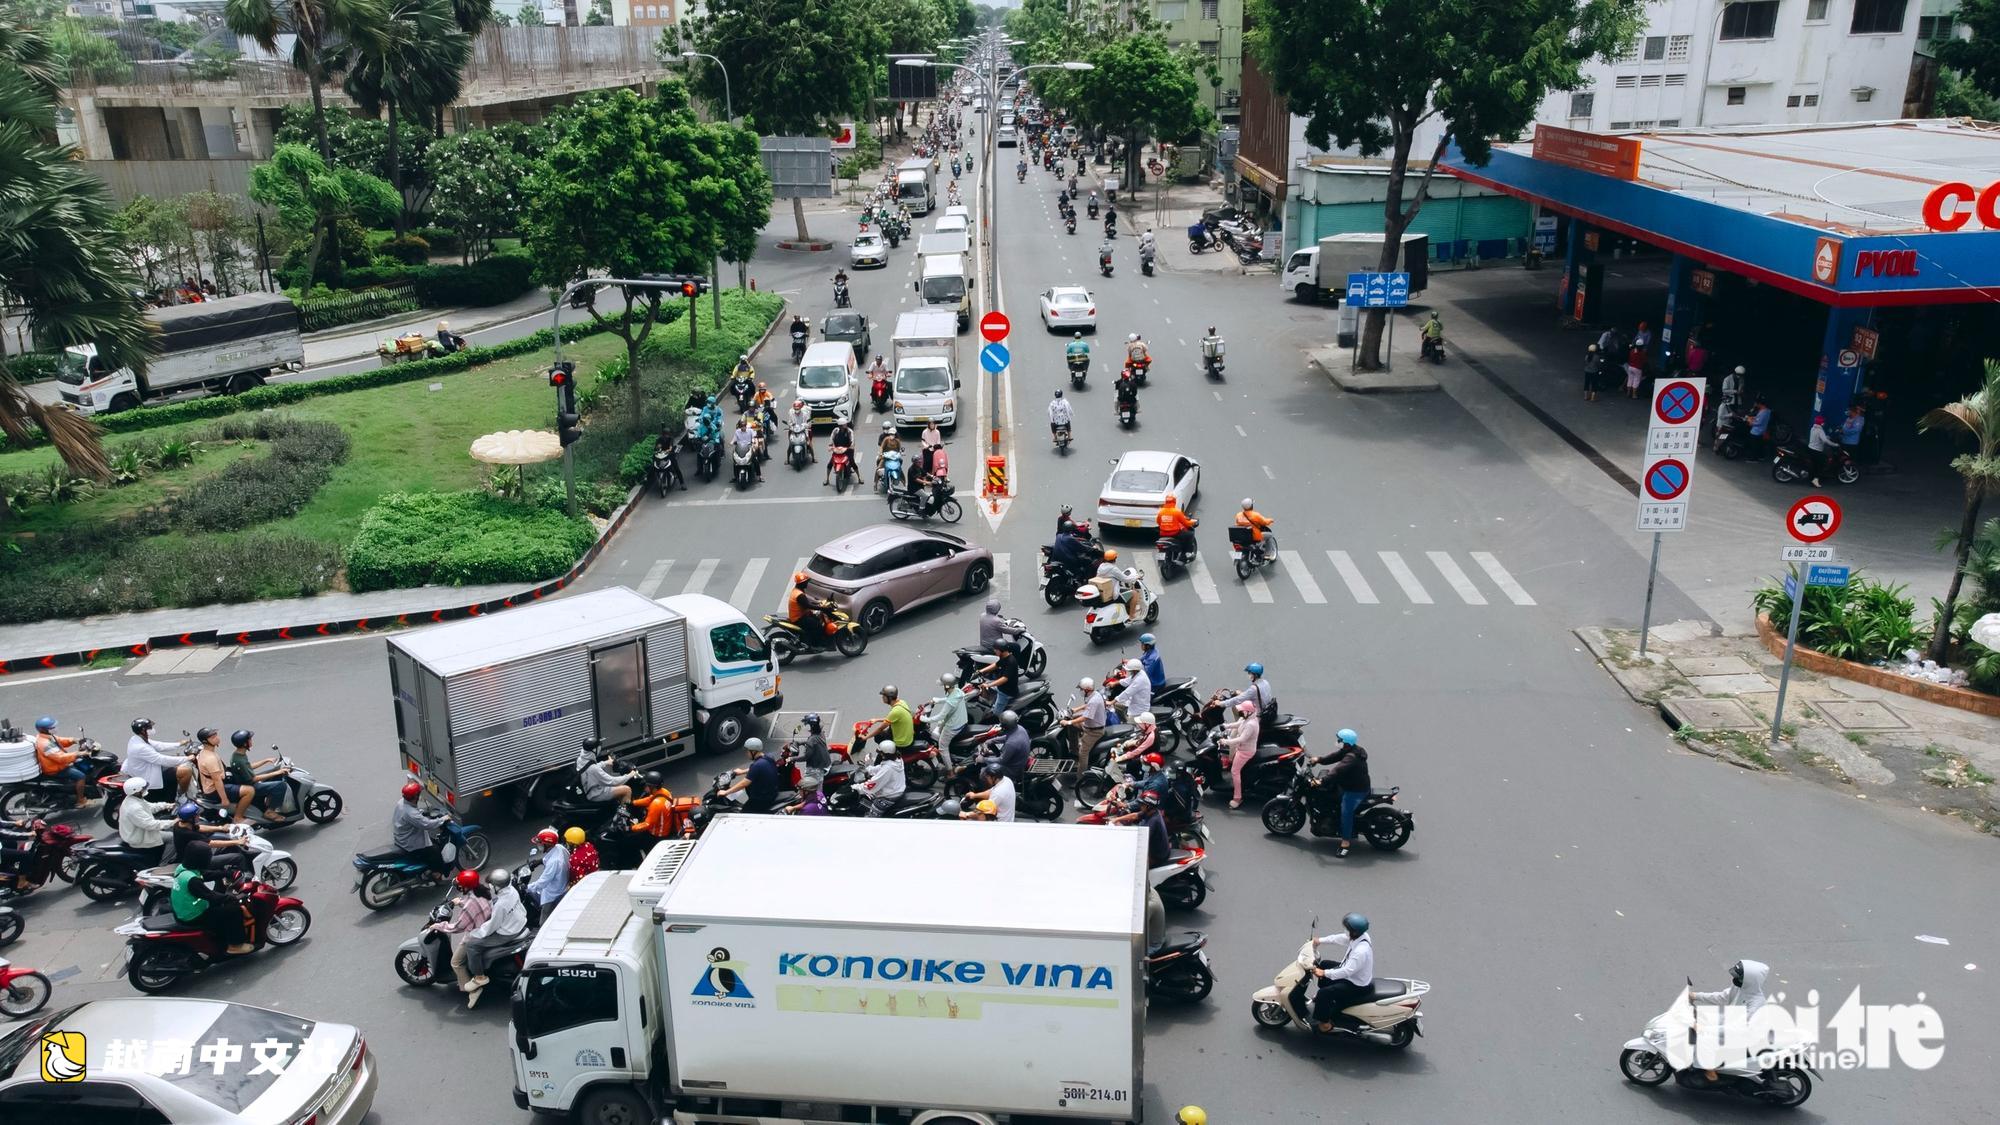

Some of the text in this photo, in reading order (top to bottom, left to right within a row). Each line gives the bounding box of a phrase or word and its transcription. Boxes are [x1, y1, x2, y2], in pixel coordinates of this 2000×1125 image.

[1854, 249, 1920, 278] PVOIL
[557, 969, 597, 978] ISUZU
[1063, 1087, 1127, 1102] 50H-214.01
